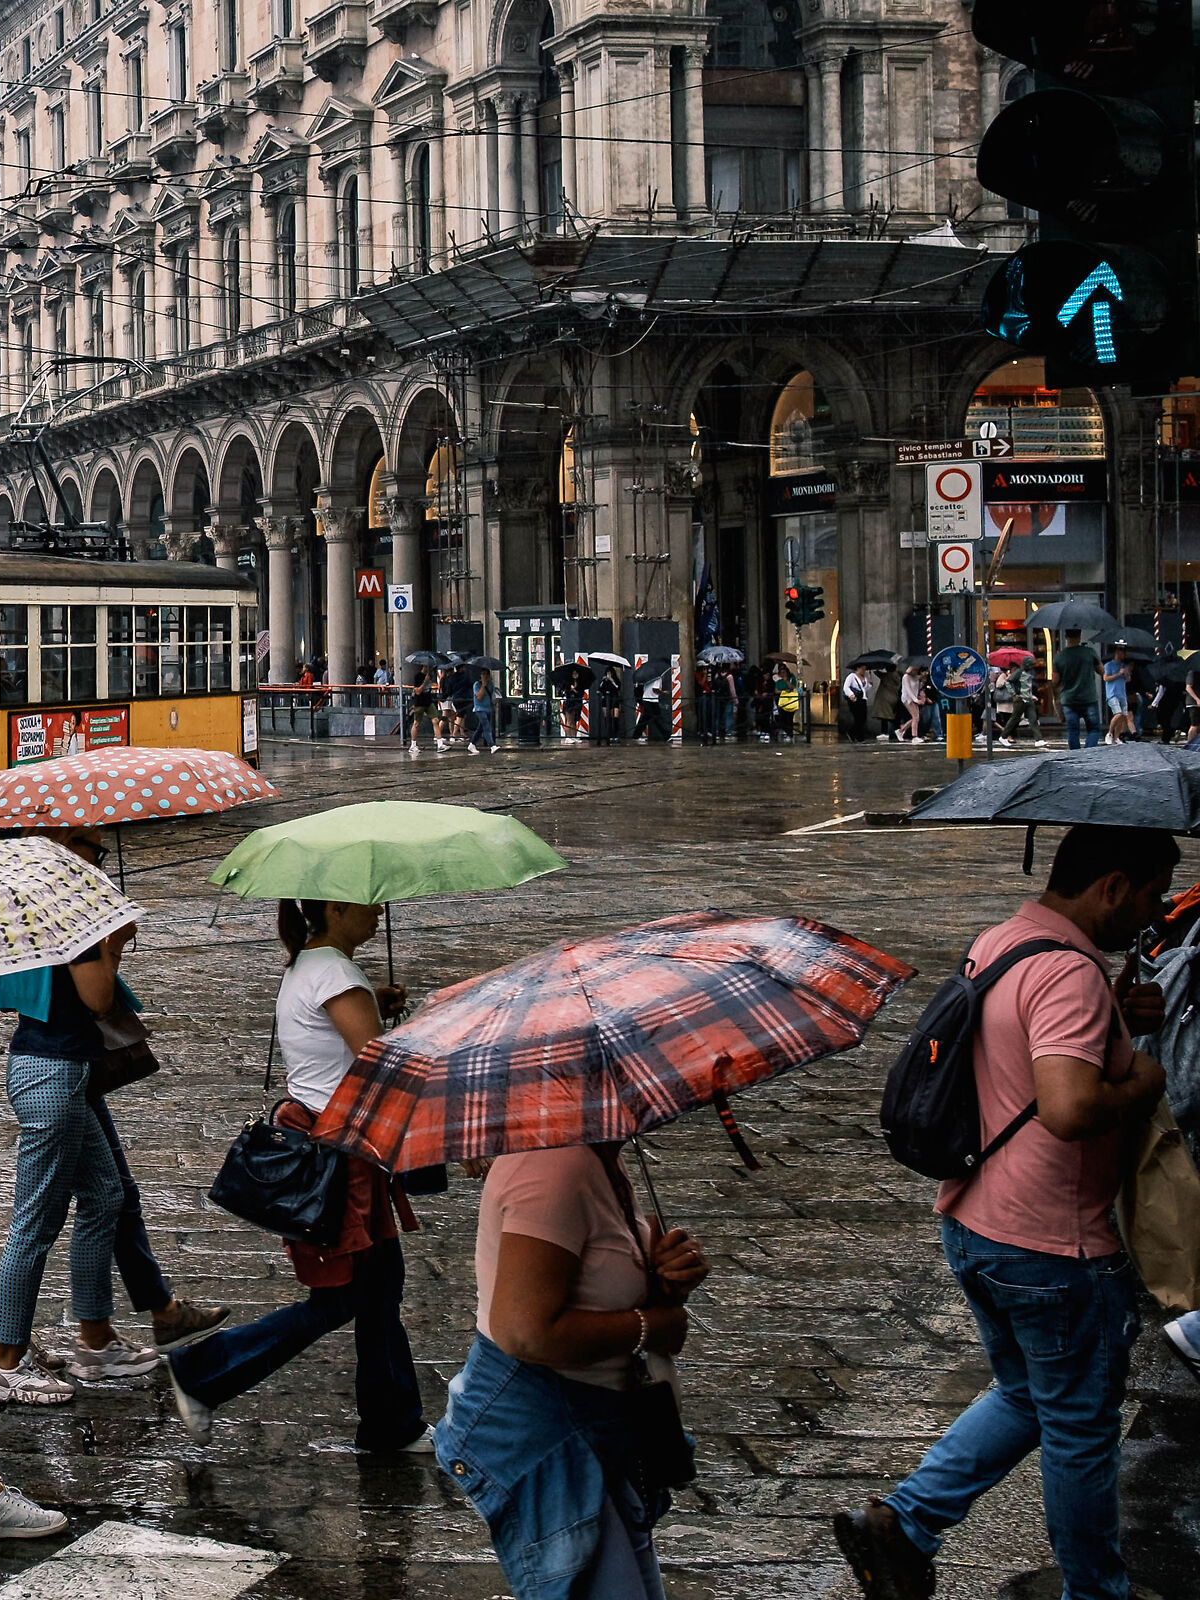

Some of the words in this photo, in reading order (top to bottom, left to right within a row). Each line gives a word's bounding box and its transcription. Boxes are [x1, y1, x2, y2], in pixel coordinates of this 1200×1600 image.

[924, 443, 952, 451] tempio
[954, 441, 963, 449] di
[918, 451, 963, 460] Sebastiano
[1009, 474, 1085, 485] MONDADORI
[791, 483, 835, 497] MONDADORI
[358, 574, 382, 593] M
